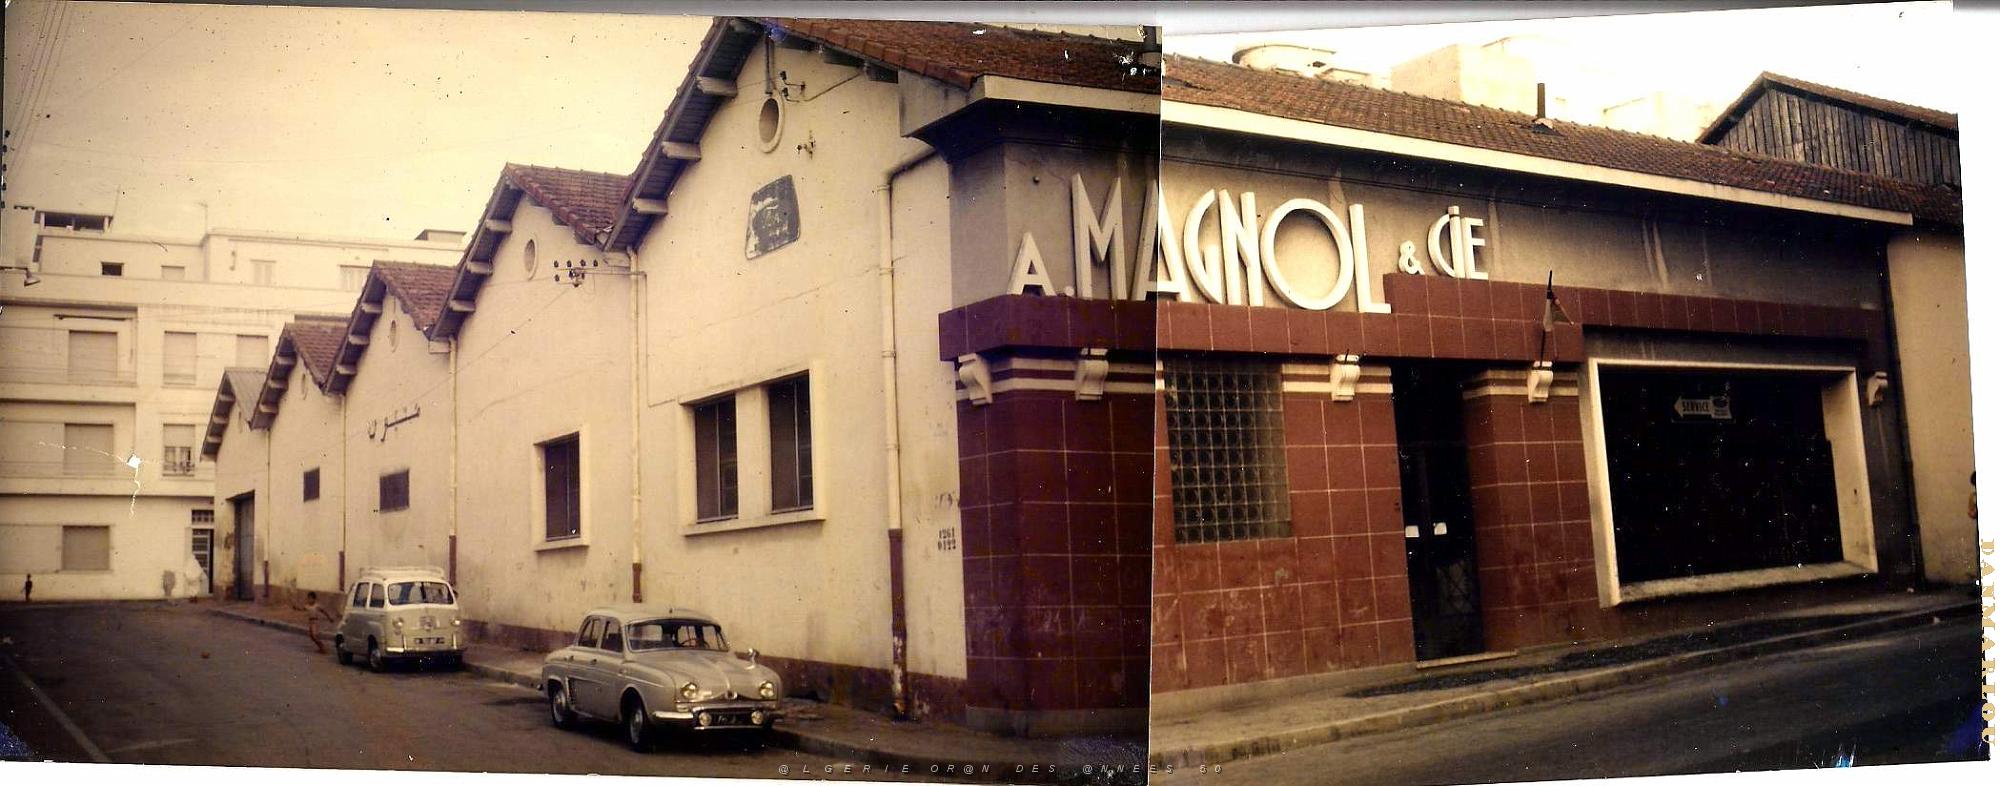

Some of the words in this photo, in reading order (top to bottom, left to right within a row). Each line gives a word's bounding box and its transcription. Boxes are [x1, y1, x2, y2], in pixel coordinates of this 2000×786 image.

[1006, 231, 1075, 297] A.
[1071, 172, 1392, 314] MAGNOL
[1399, 239, 1425, 275] &
[1683, 401, 1709, 412] SERVICE
